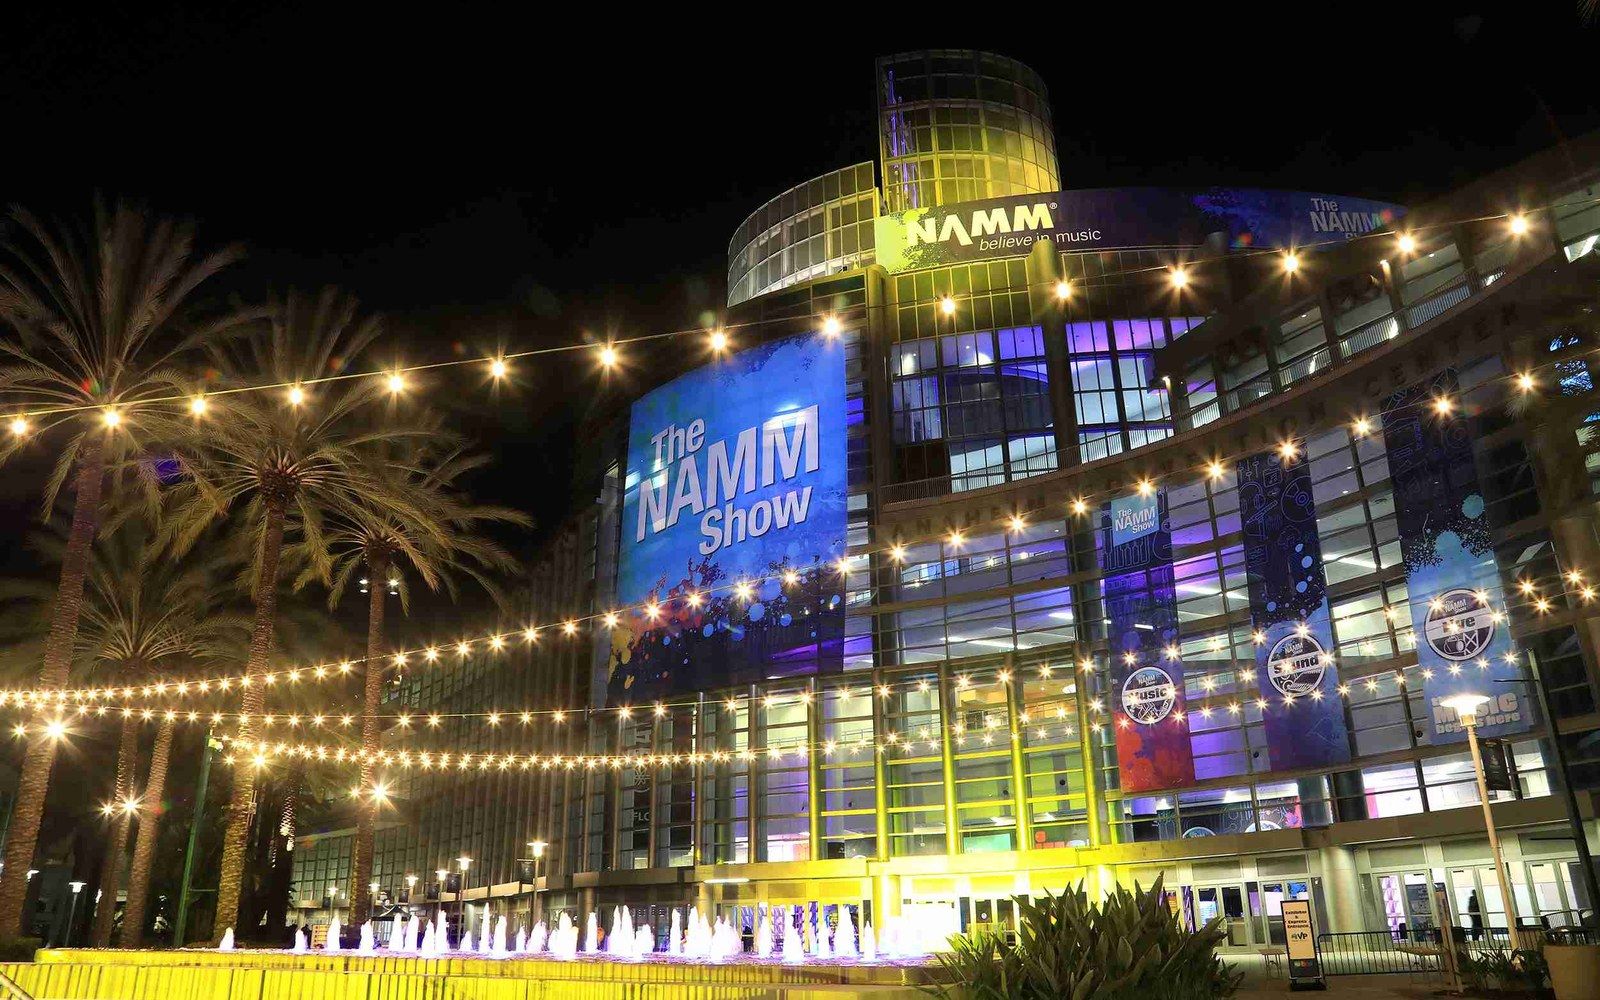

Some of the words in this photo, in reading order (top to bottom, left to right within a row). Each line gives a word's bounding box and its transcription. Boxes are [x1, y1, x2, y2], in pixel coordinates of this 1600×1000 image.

[1310, 198, 1339, 212] The
[979, 234, 1032, 252] believe
[1055, 227, 1102, 244] music
[650, 417, 705, 472] The
[636, 404, 820, 543] NAMM
[698, 485, 814, 556] Show
[1114, 506, 1156, 532] NAMM
[1117, 508, 1133, 519] The
[1132, 520, 1155, 534] Show
[1442, 616, 1476, 634] Lve
[1273, 654, 1320, 675] Sund
